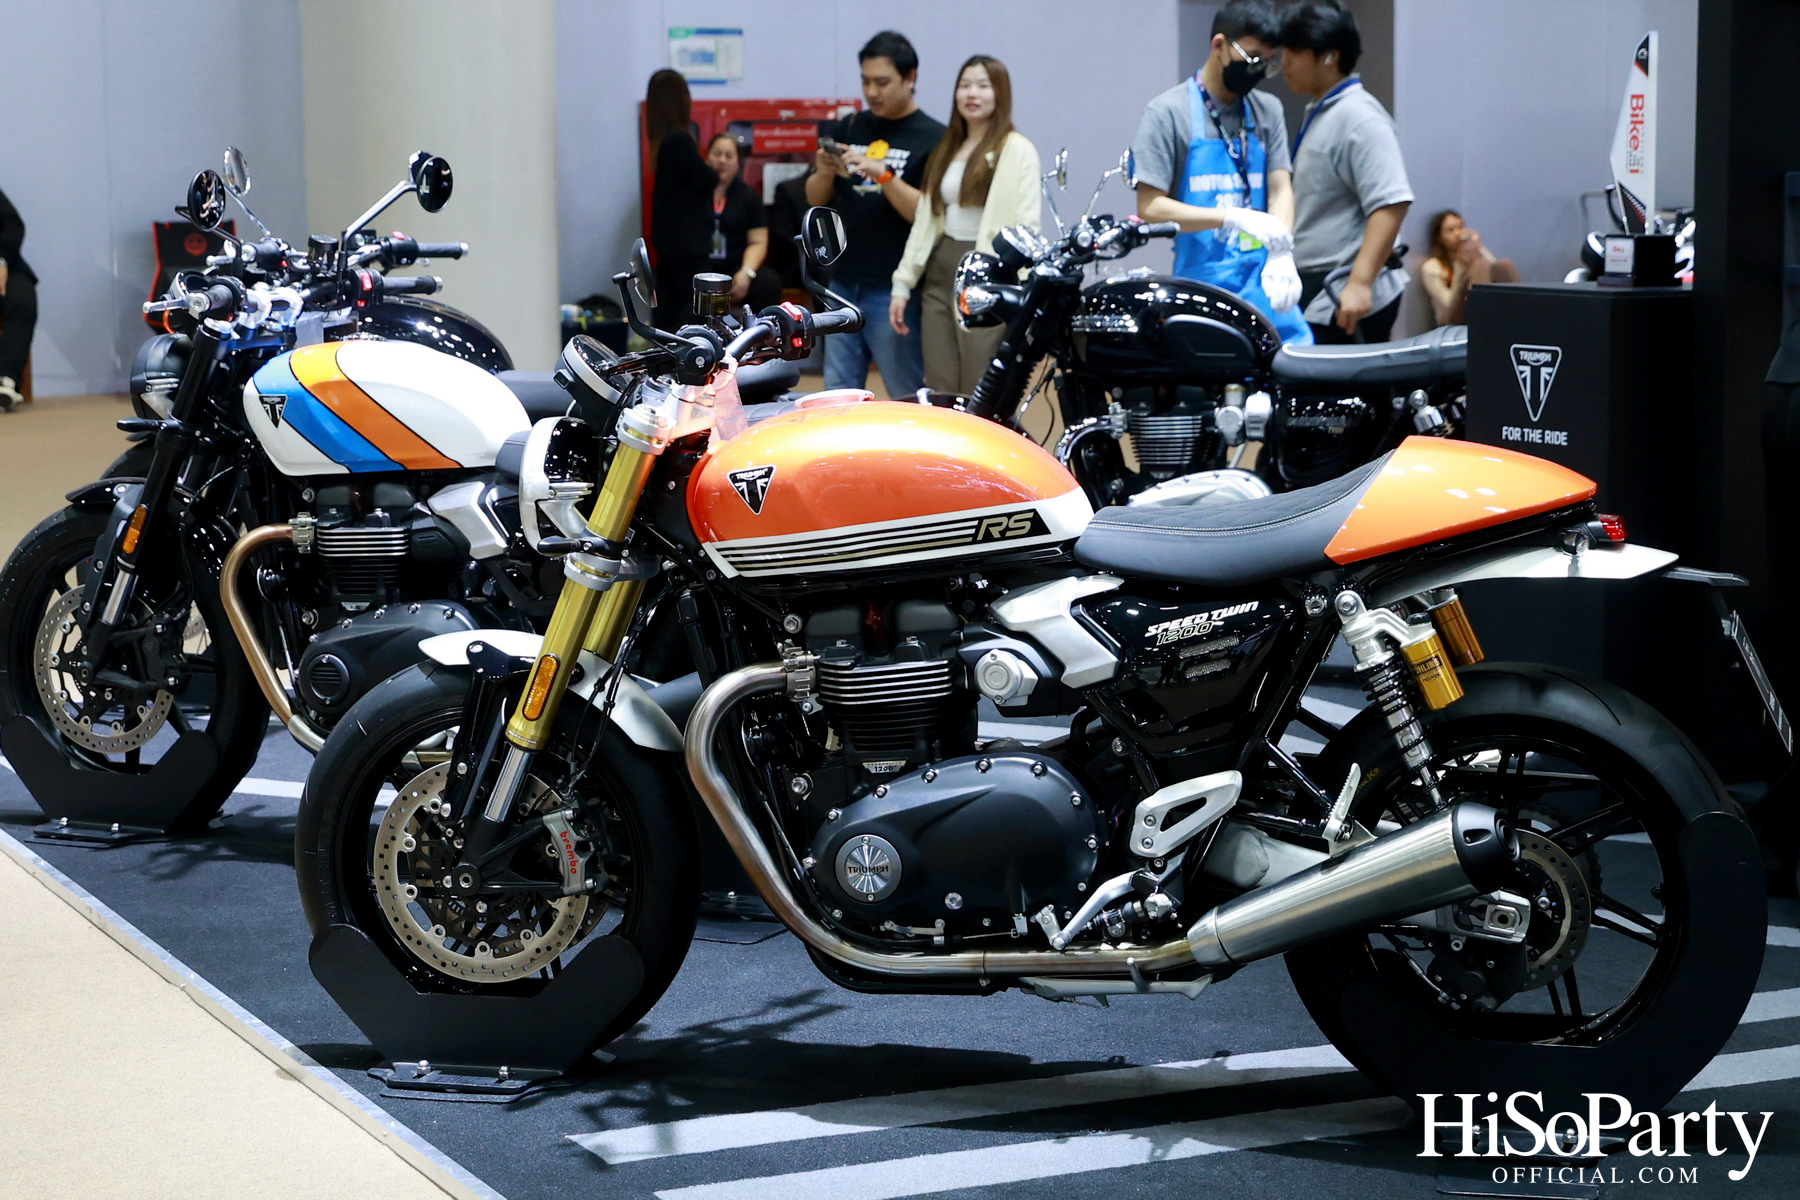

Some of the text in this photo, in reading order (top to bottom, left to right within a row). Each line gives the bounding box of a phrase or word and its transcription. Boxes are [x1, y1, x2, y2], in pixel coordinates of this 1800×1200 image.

[1629, 94, 1645, 151] Bike
[1519, 350, 1552, 363] TRIUMPH
[1502, 426, 1569, 446] FOR THE RIDE
[735, 468, 766, 480] TRIUMPH
[976, 512, 1034, 541] RS
[1144, 600, 1259, 637] SPEED TWIN
[1156, 620, 1214, 646] 1200
[560, 831, 578, 875] brembo
[847, 865, 889, 873] TRIUMPH
